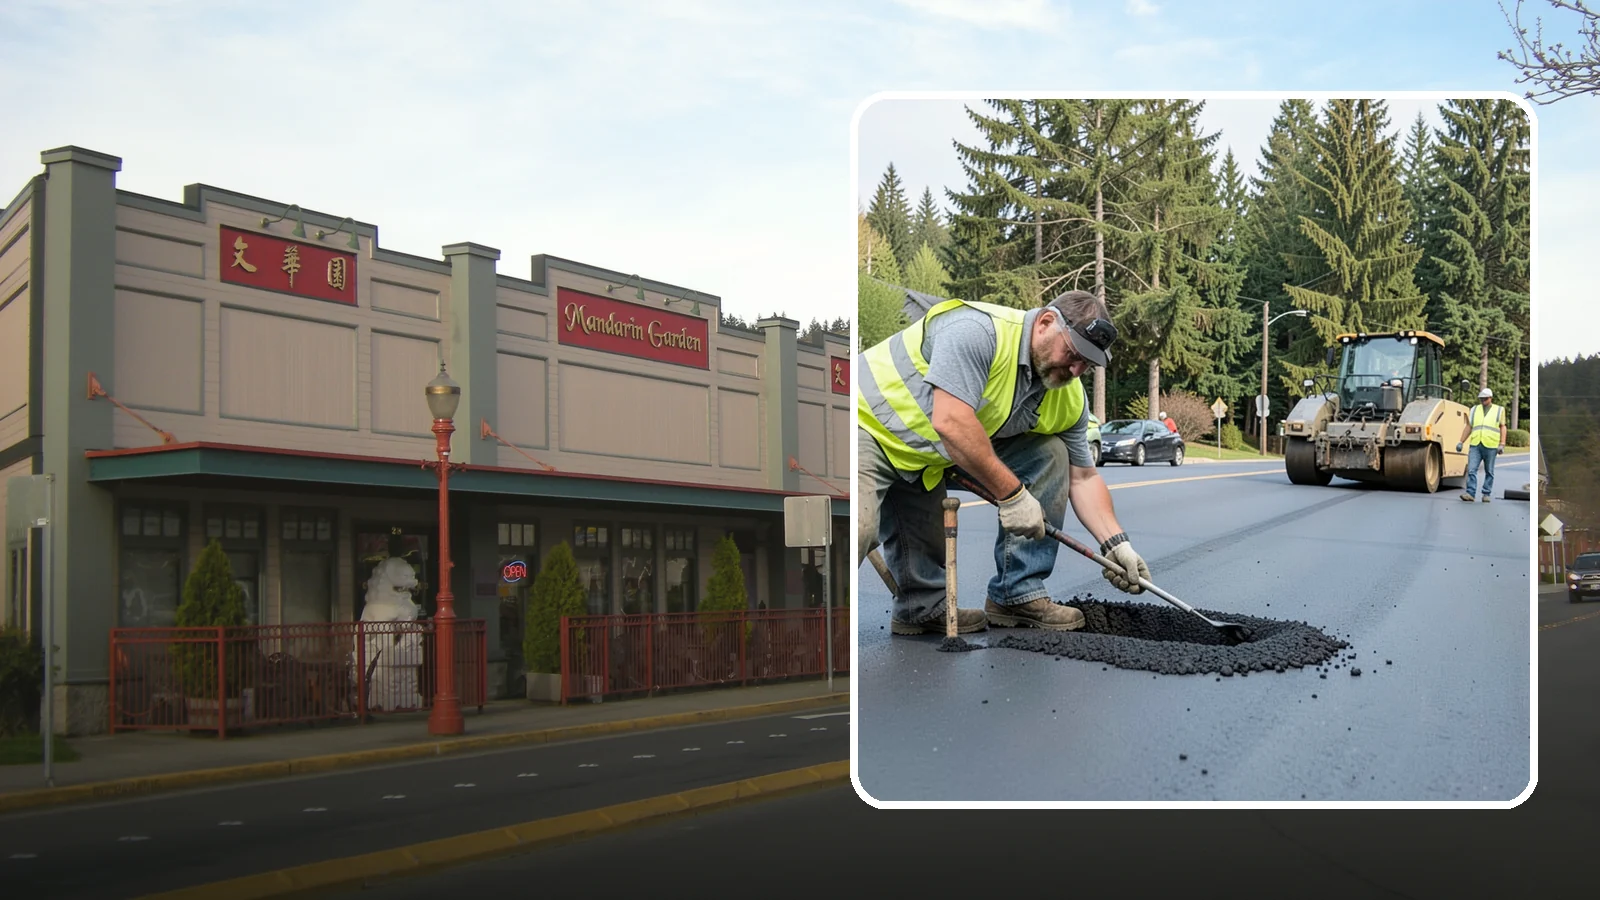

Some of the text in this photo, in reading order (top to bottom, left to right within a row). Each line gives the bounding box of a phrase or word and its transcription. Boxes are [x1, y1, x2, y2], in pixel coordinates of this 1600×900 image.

[564, 302, 701, 352] Mandarin Garden
[503, 565, 527, 578] OPEN
